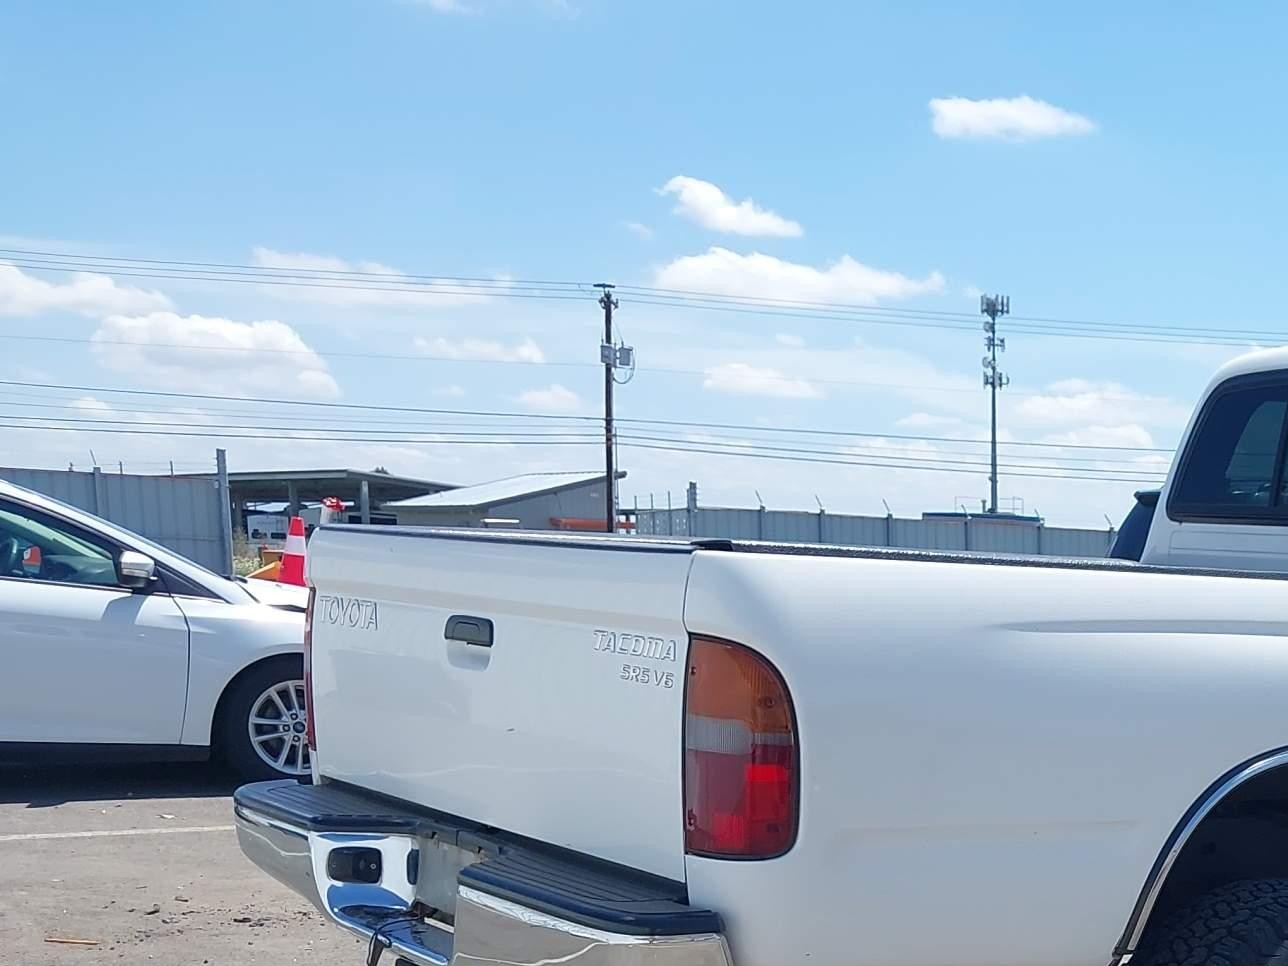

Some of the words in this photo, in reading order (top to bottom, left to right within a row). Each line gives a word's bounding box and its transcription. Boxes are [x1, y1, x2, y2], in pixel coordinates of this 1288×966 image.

[319, 596, 379, 631] TOYOTA
[593, 629, 677, 662] TACOMA
[620, 664, 650, 684] SR5
[653, 670, 675, 689] V6
